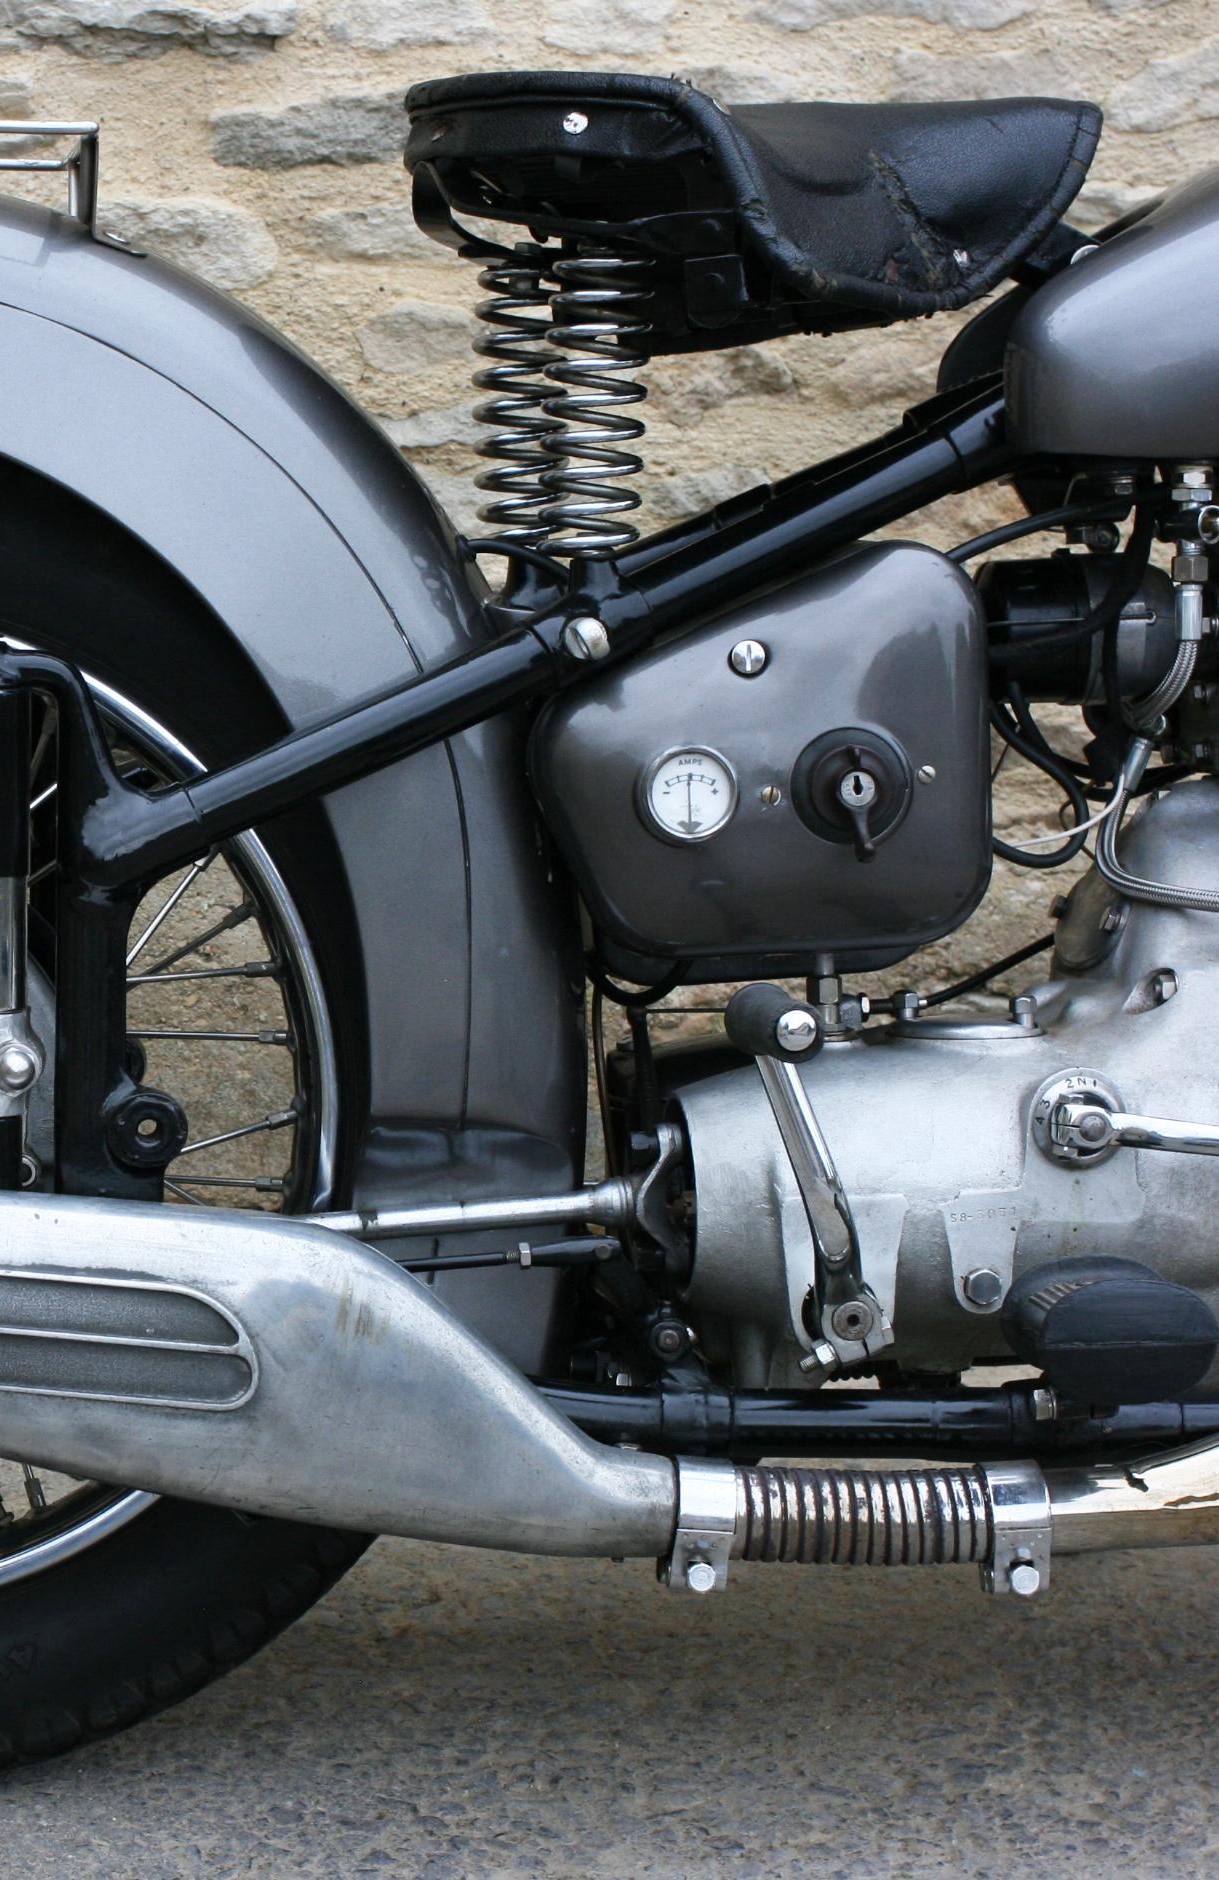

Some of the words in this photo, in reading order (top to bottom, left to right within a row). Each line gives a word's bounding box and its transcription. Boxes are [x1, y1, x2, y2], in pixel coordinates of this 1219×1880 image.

[678, 758, 703, 766] AMPS
[1035, 1117, 1045, 1125] 4
[1040, 1099, 1051, 1110] 3
[1064, 1078, 1075, 1089] 2
[1077, 1078, 1086, 1086] N
